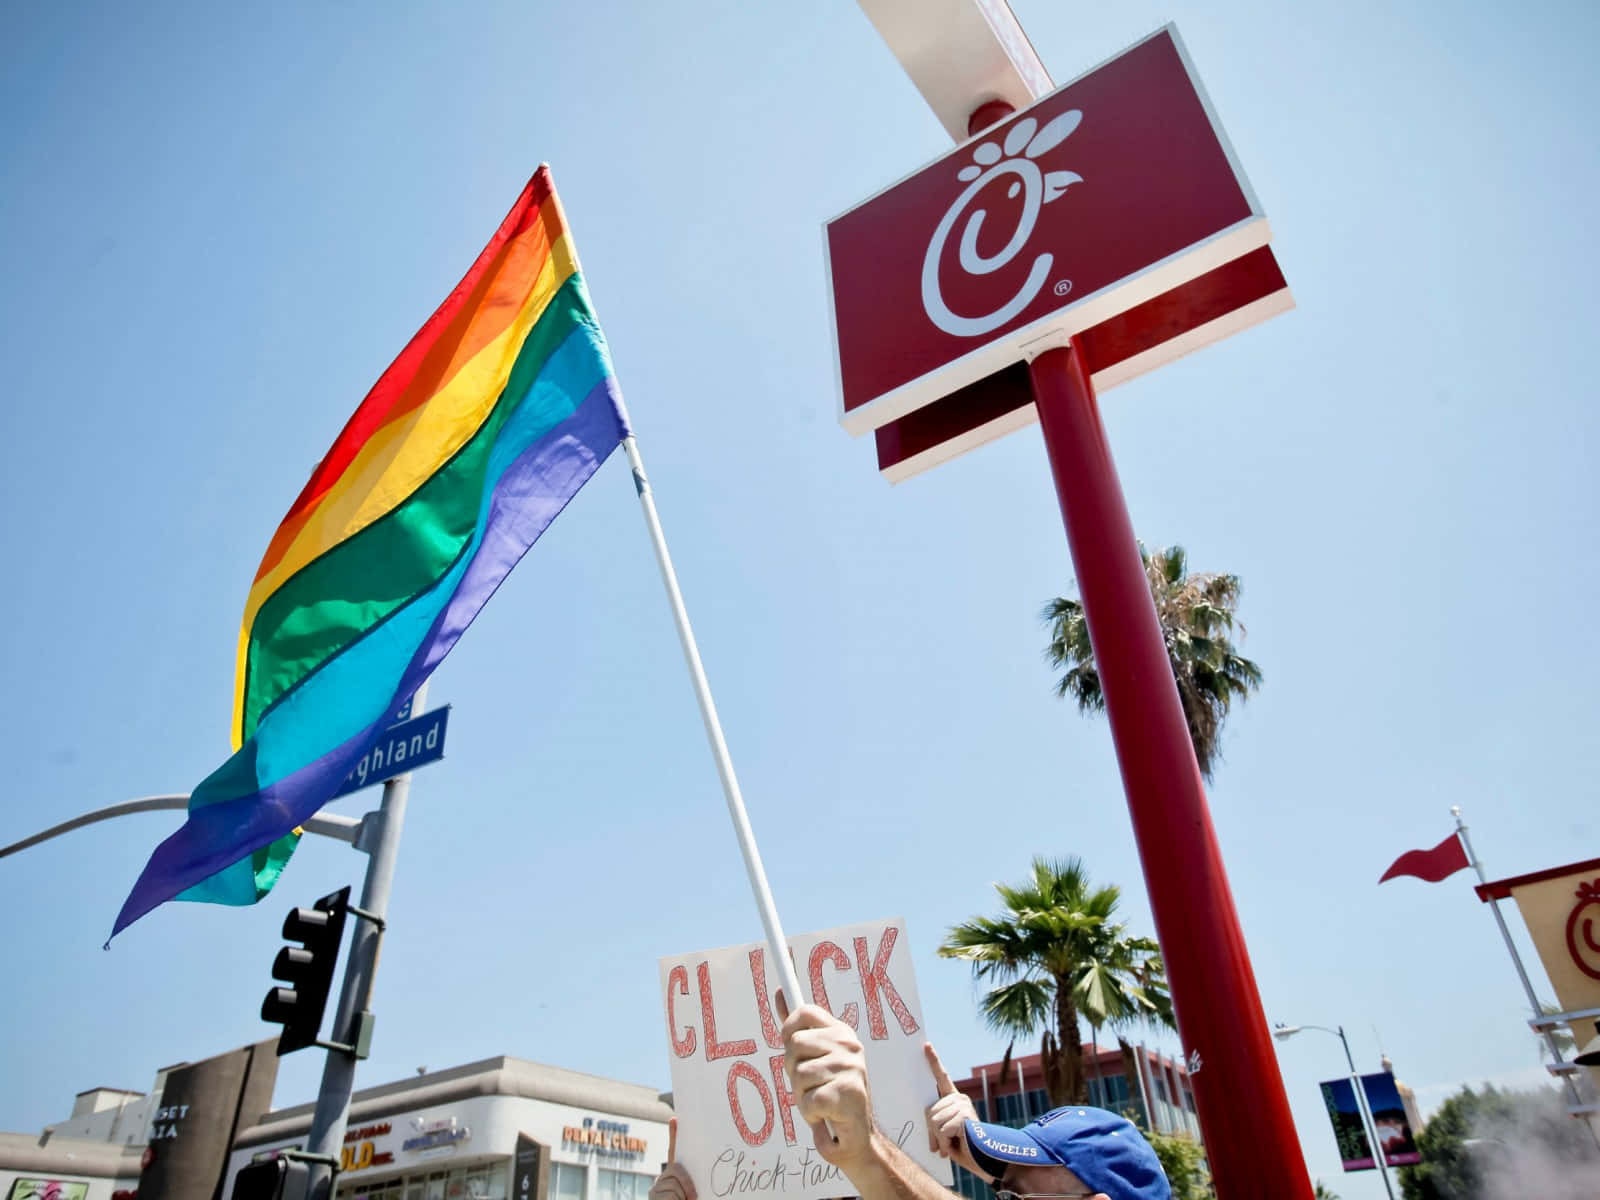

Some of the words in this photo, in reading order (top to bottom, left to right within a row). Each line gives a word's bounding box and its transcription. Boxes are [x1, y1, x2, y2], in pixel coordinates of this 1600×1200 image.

[348, 721, 439, 786] ghland
[667, 926, 920, 1062] CLUCK
[156, 1104, 190, 1120] SET
[727, 1054, 798, 1147] OF
[562, 1126, 608, 1147] DENTAL
[983, 1137, 1038, 1157] ANGELES
